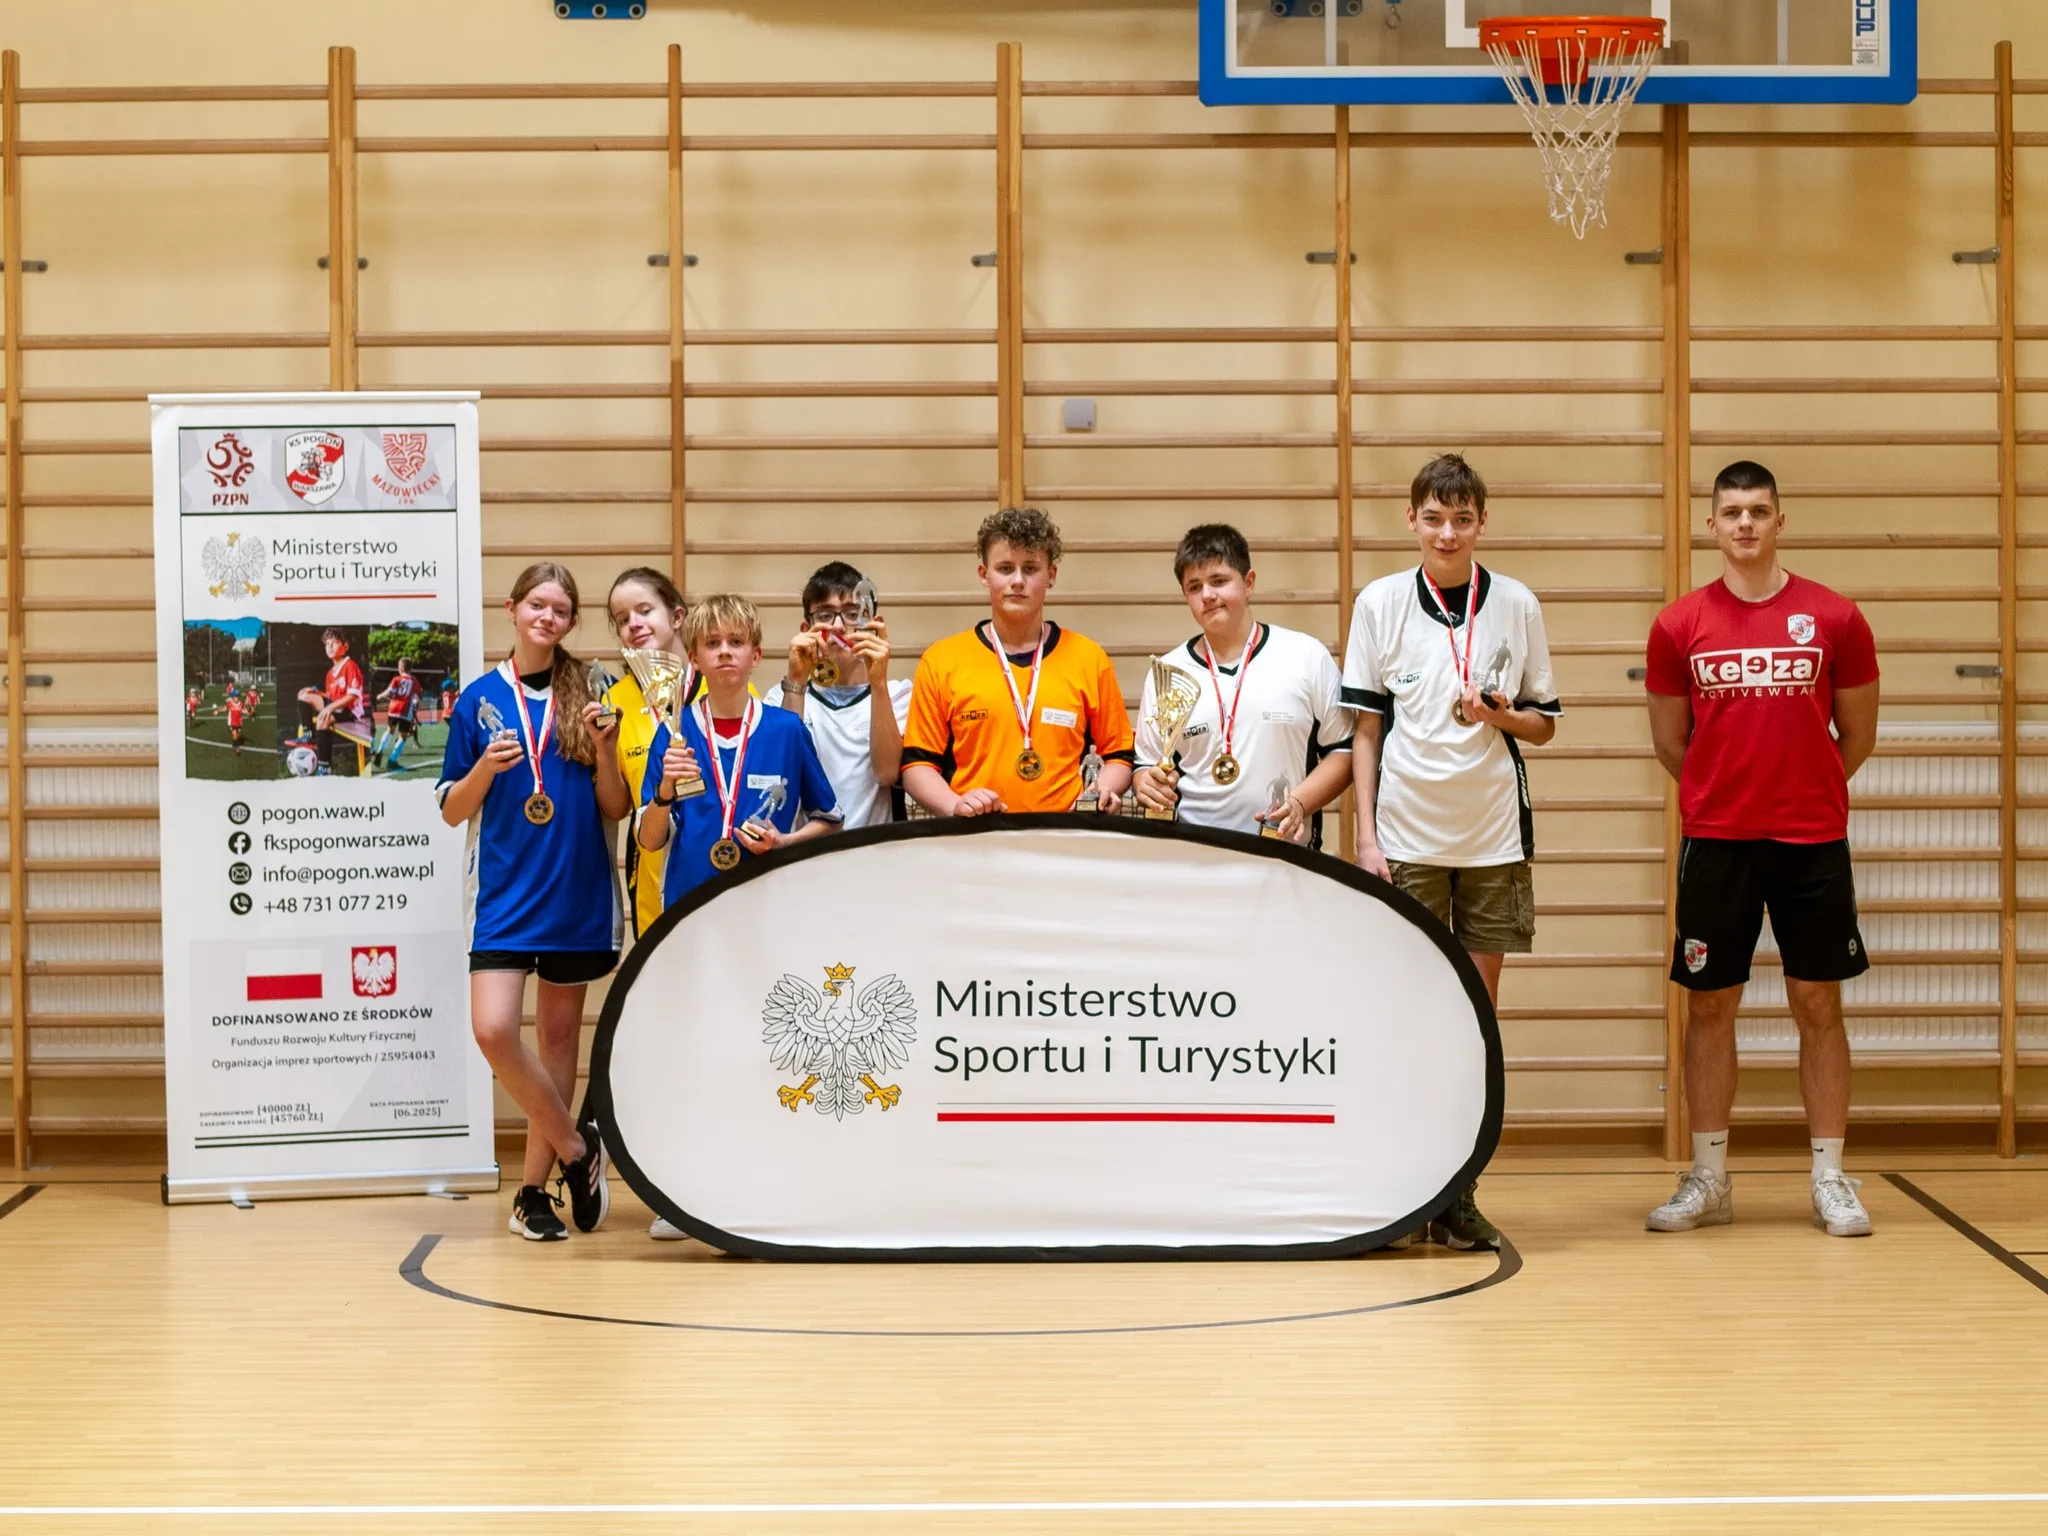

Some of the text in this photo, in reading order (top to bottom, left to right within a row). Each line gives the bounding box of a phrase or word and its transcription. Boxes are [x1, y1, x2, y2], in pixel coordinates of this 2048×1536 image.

[294, 482, 336, 492] WARSZAWA
[372, 473, 440, 496] MAZOWIECKI
[212, 494, 249, 506] PZPN
[272, 538, 398, 556] Ministerstwo
[272, 560, 437, 583] Sportu i Turystyki
[1700, 687, 1816, 700] ACTIVEWEAR
[262, 802, 385, 824] pogon.waw.pl
[264, 834, 430, 853] fkspogonwarszawa
[263, 862, 434, 884] info@pogon.waw.pl
[264, 894, 407, 914] +48 731 077 219
[936, 980, 1237, 1018] Ministerstwo
[212, 1006, 433, 1027] DOFINANSOWANO ZE ŚRODKÓW
[231, 1029, 416, 1047] Funduszu Rozwoju Kultury Fizycznej
[212, 1050, 435, 1071] Organizacja imprez sportowych / 25954043
[934, 1036, 1337, 1082] Sportu i Turystyki
[394, 1106, 441, 1119] [06.2025]
